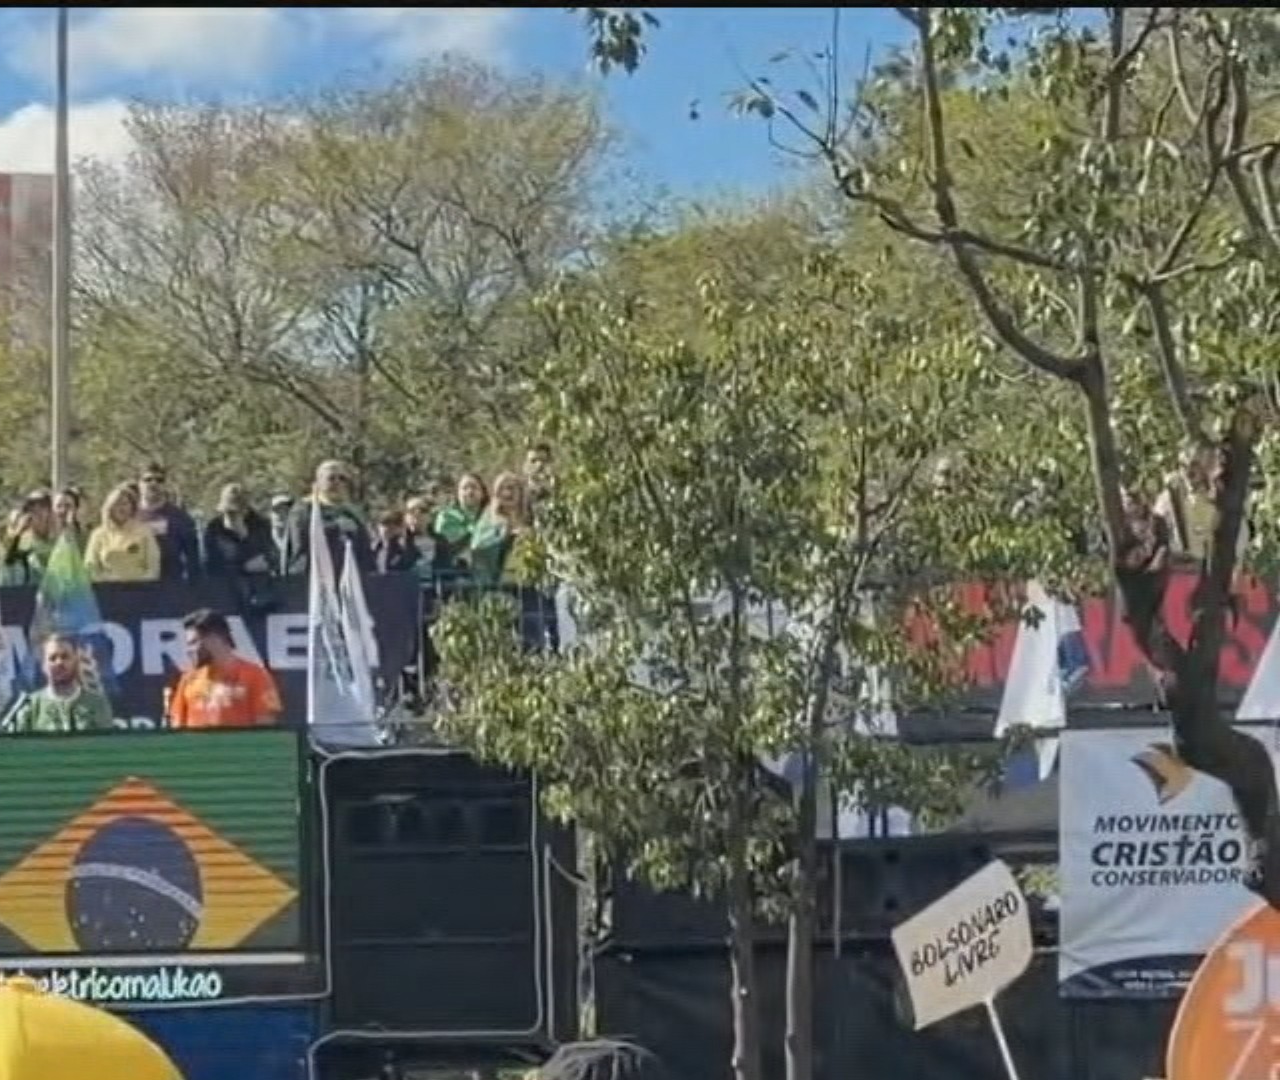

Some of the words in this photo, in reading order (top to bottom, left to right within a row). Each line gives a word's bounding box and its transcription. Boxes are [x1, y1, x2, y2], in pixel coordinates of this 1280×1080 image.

[1091, 833, 1242, 868] CRISTÃO
[911, 890, 1018, 976] BOLSONARO
[944, 928, 1001, 987] LIVRE
